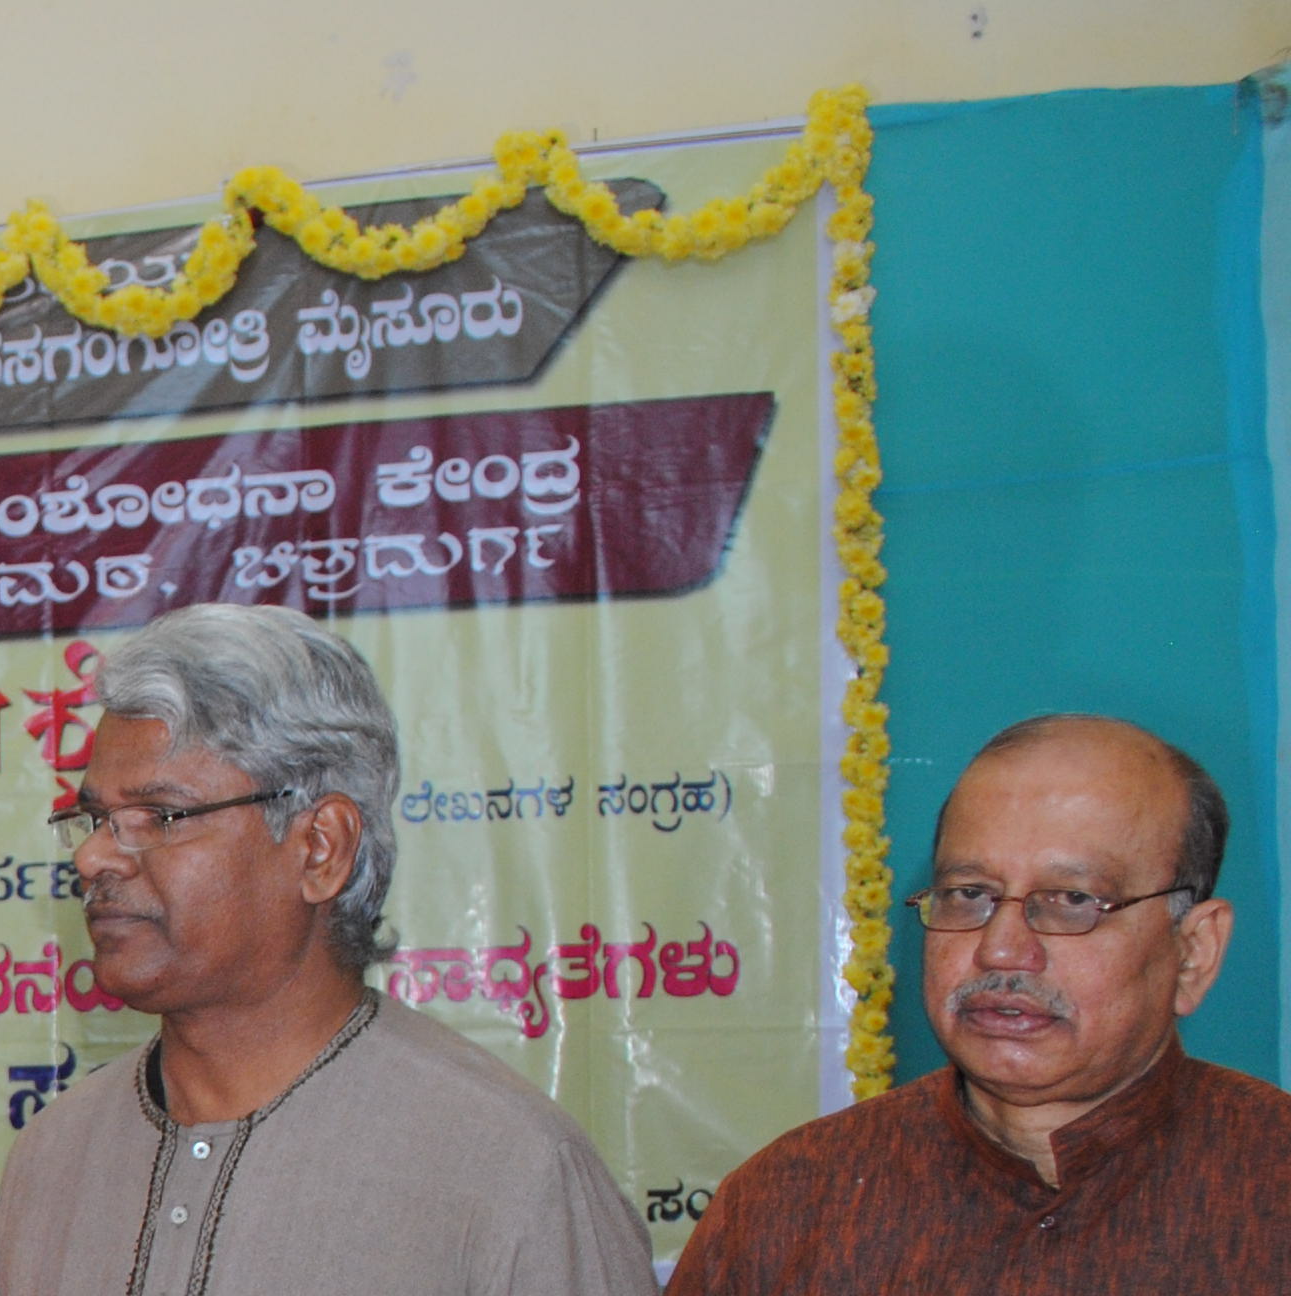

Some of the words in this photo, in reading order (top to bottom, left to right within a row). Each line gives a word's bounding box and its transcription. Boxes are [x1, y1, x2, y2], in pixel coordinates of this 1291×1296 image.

[297, 276, 523, 380] ಮೈಸೂರು
[376, 435, 581, 514] ಕೇಂದ್ರ
[233, 523, 564, 600] ಚಿತ್ರದುರ್ಗ
[401, 776, 574, 824] ಲೇಖನಗಳ
[598, 770, 733, 831] ಸಂಗ್ರಹ)
[387, 920, 740, 1038] ಸಾಧ್ಯತೆಗಳು
